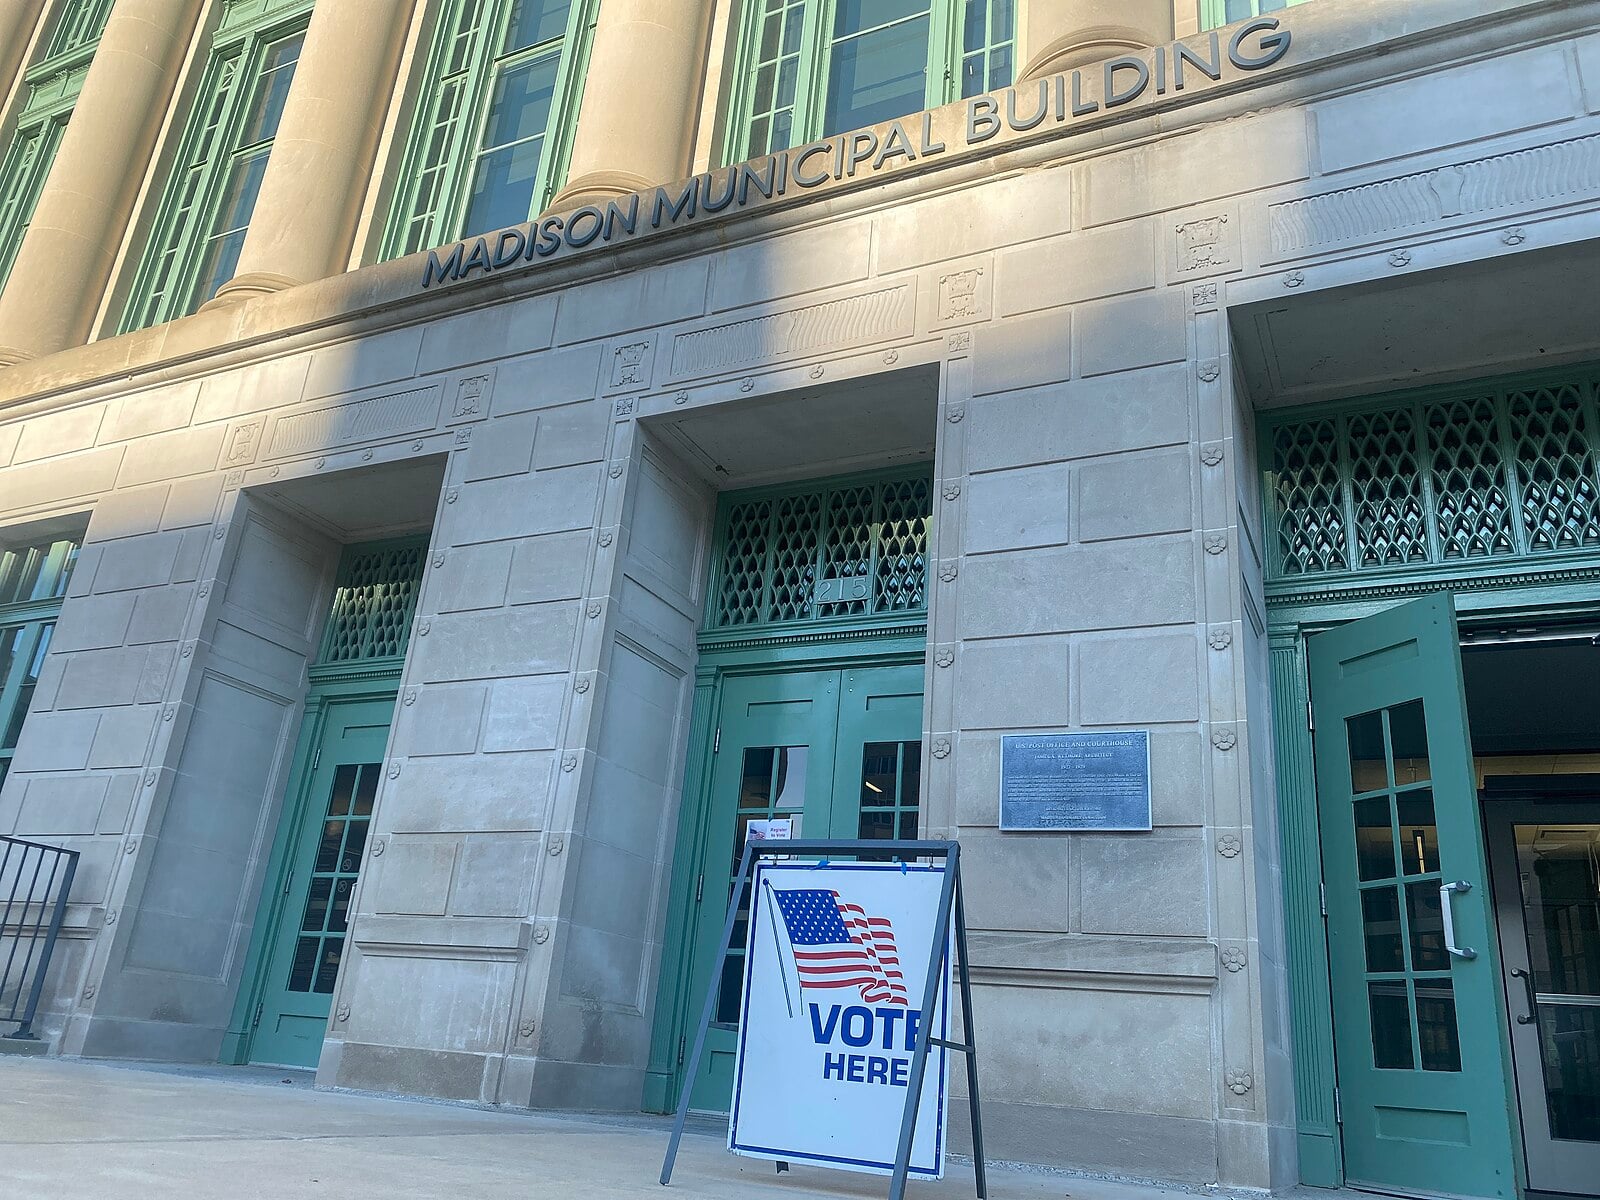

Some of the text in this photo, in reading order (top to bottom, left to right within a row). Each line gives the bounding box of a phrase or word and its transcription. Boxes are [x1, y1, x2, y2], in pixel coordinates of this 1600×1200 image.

[422, 17, 1292, 288] MADISON MUNICIPAL BUILDING
[818, 577, 867, 602] 215
[1028, 741, 1045, 749] POST
[1046, 741, 1069, 749] OFFICE
[1071, 740, 1086, 748] AND
[808, 1002, 931, 1053] VOTE
[823, 1052, 909, 1087] HERE
